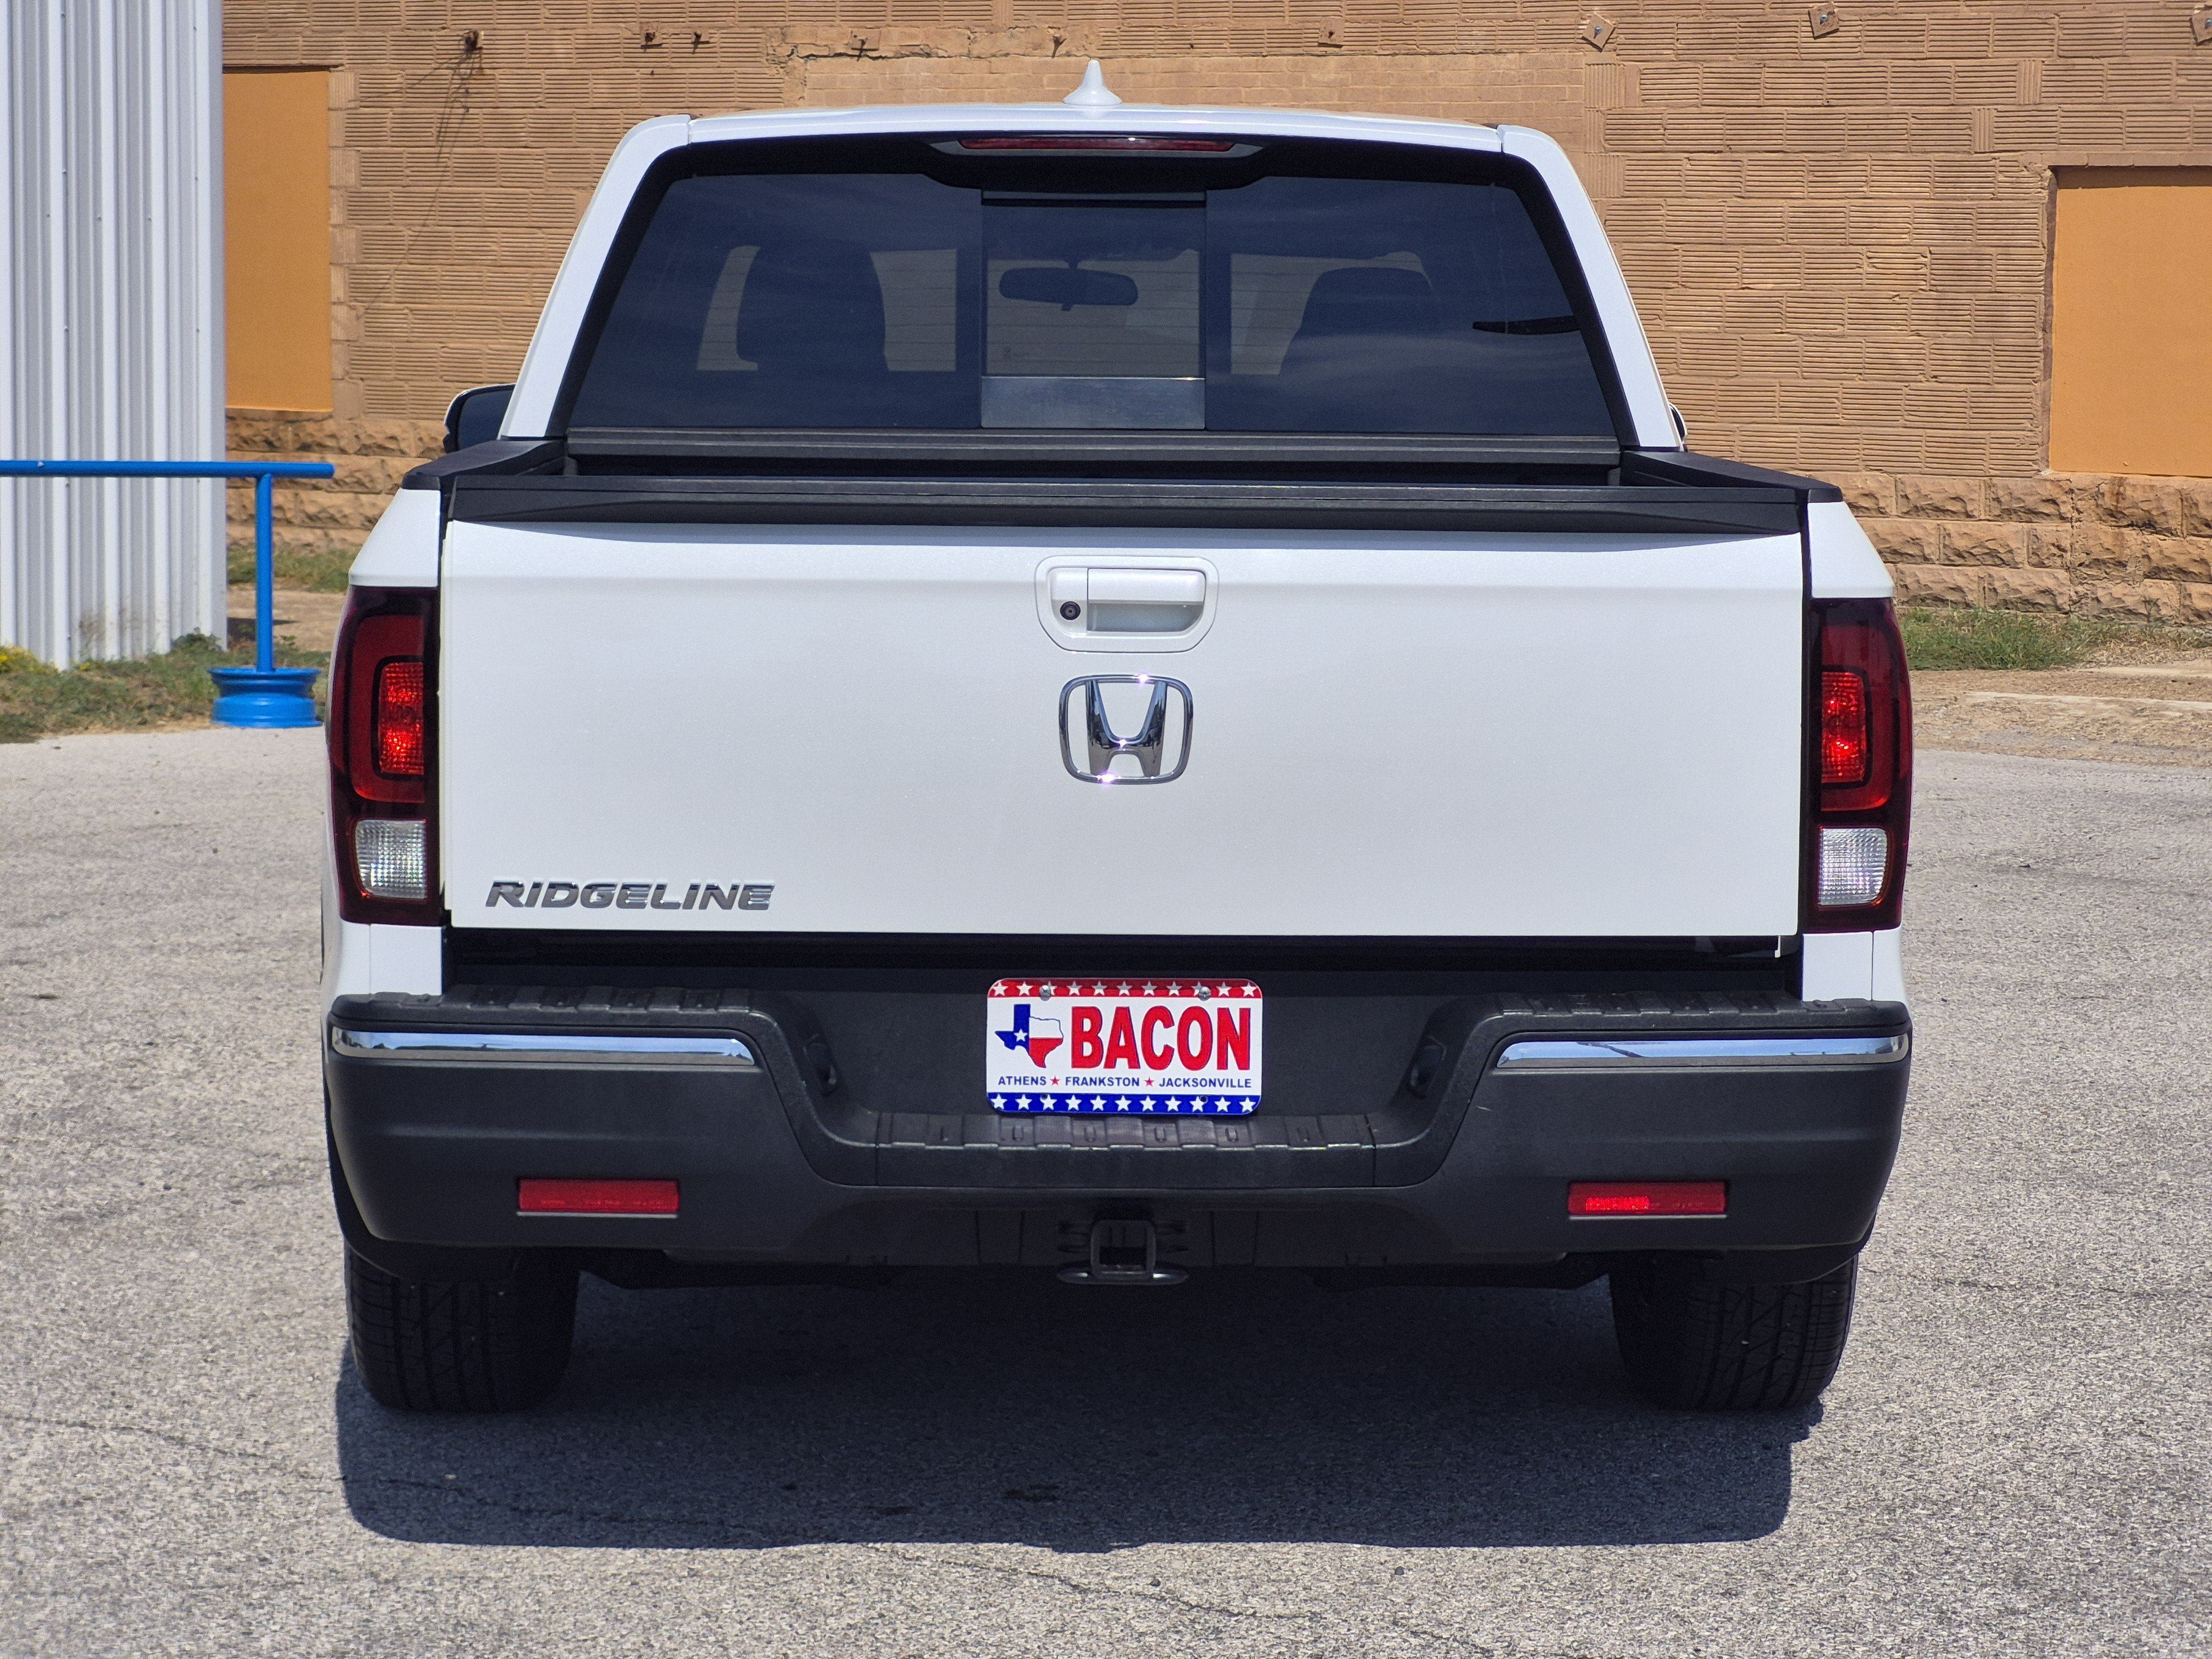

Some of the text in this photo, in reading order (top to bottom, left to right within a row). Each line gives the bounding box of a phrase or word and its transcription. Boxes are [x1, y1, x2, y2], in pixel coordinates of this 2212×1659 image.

[486, 880, 775, 910] RIDGELINE
[1071, 1006, 1251, 1071] BACON
[998, 1076, 1251, 1088] ATHENS FRANKSTON JACKSONVILLE
